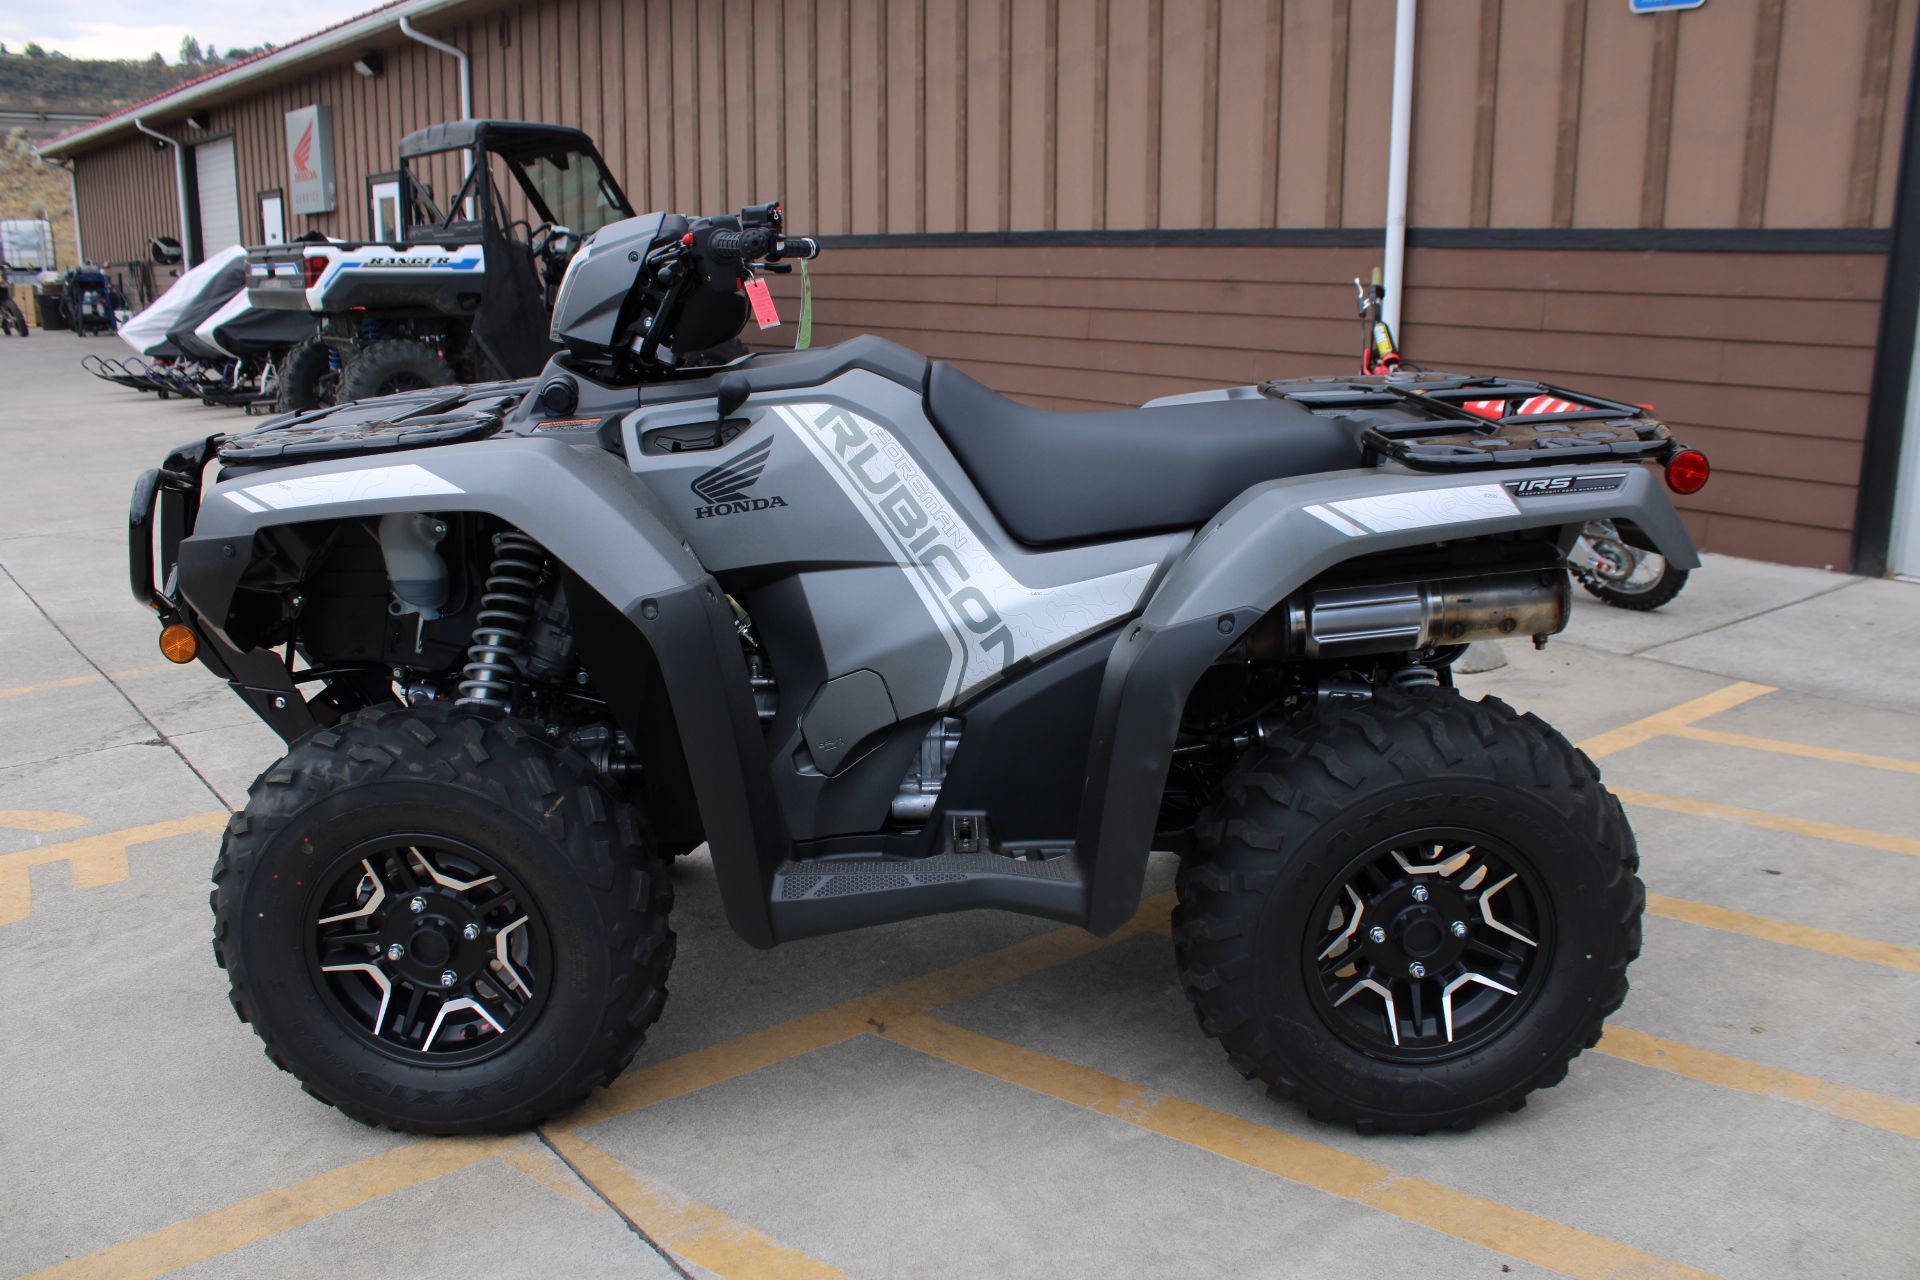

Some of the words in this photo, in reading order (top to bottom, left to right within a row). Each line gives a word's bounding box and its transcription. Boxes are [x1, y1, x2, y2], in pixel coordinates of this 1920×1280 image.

[370, 256, 450, 265] RANGER
[870, 427, 967, 549] FOREMAN
[1518, 477, 1573, 492] IRS
[694, 496, 788, 519] HONDA
[814, 405, 1014, 673] RUBICON
